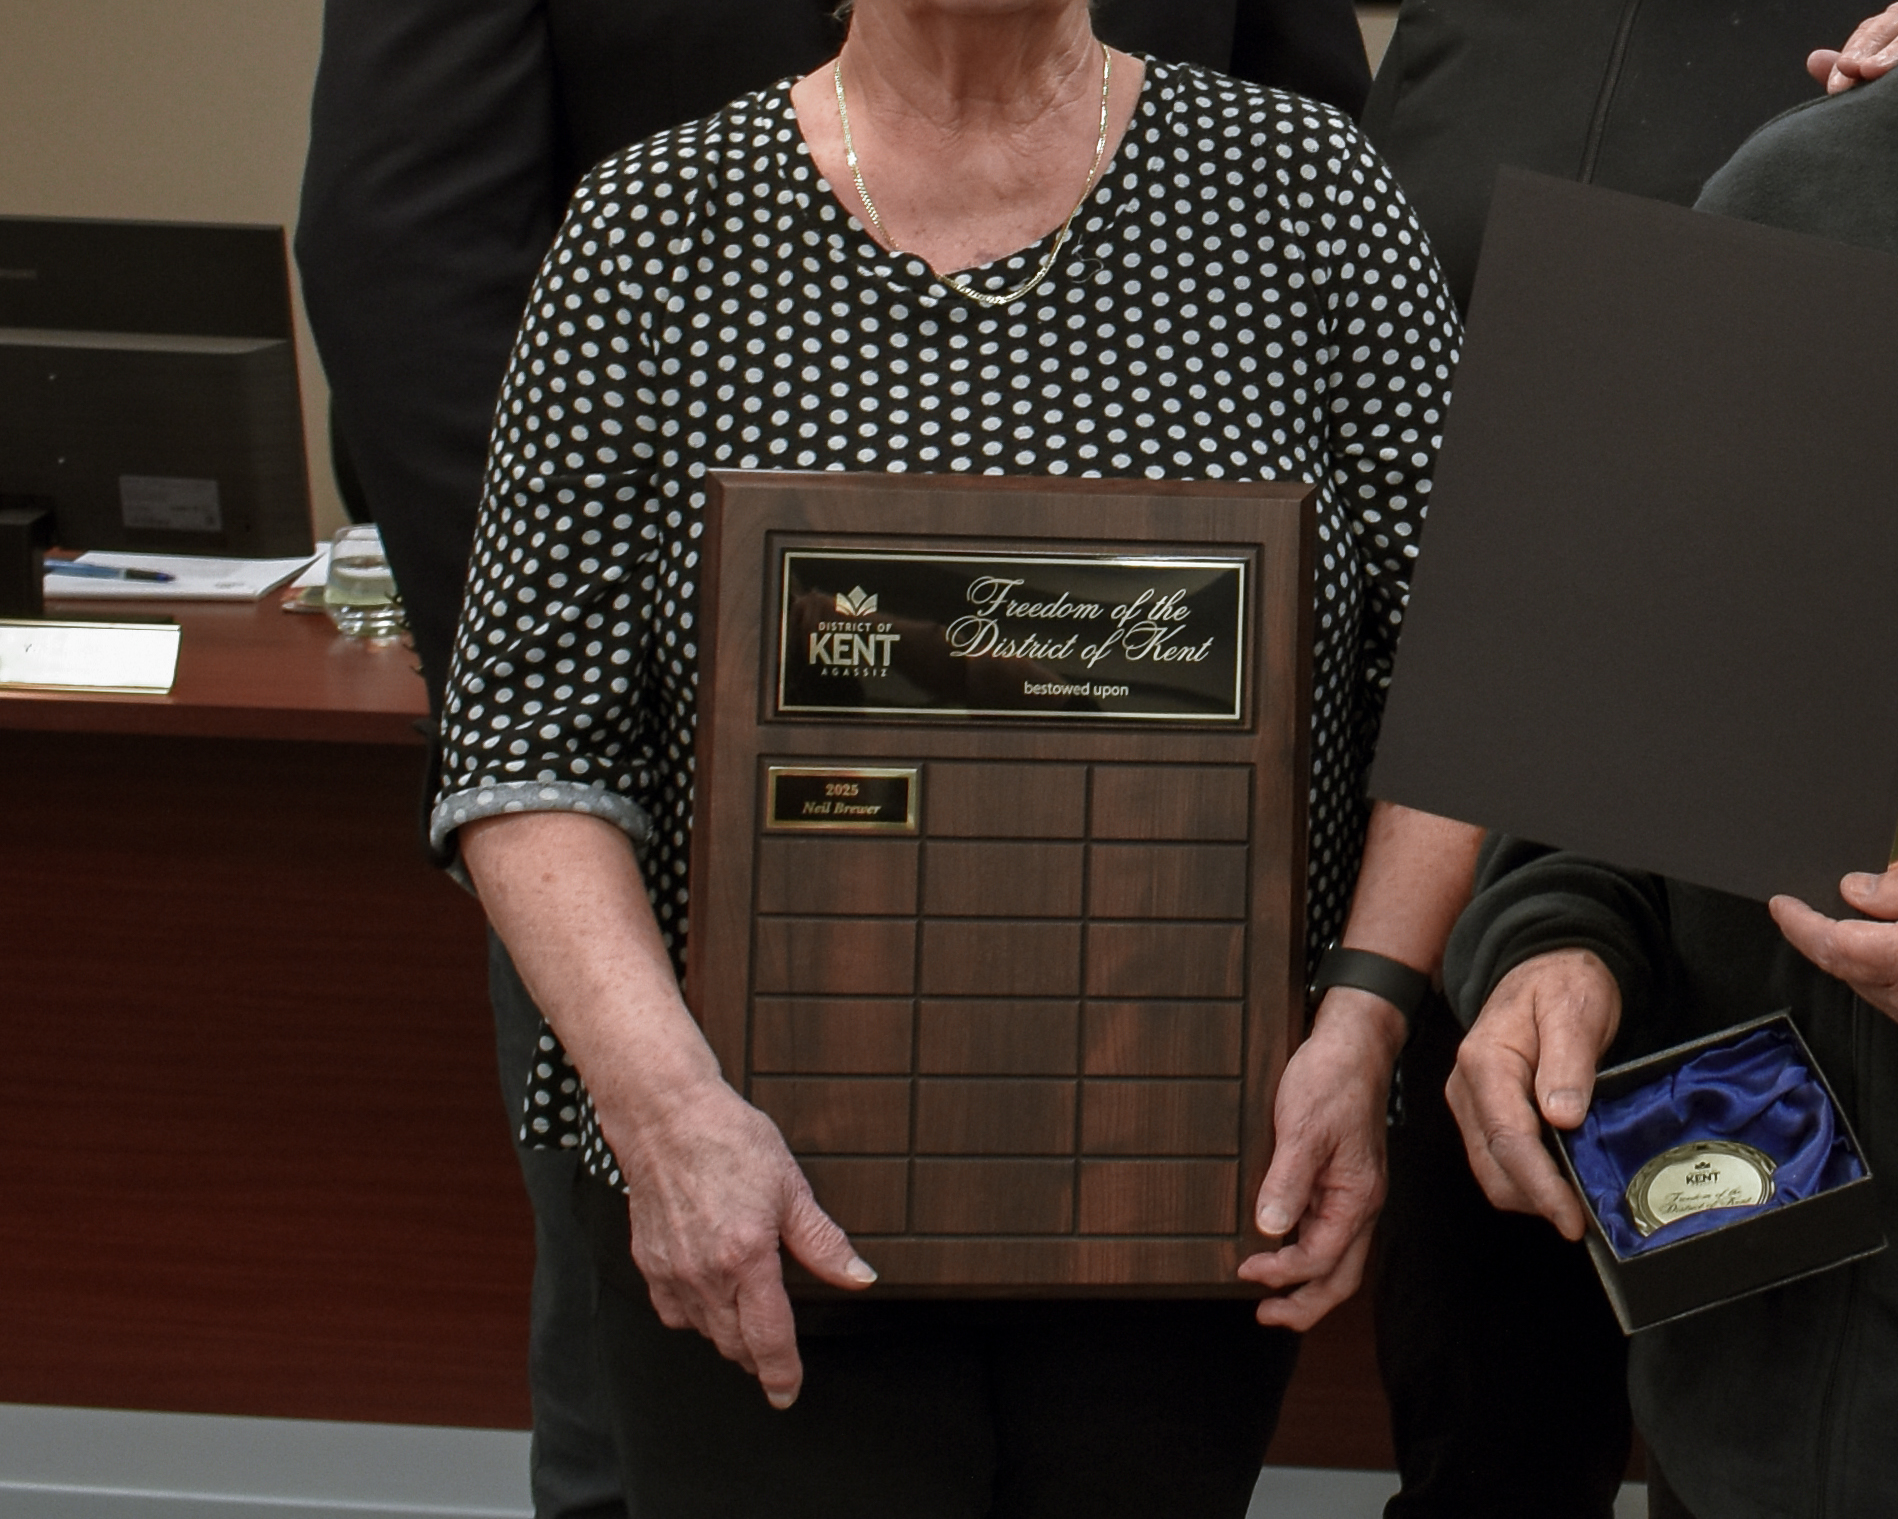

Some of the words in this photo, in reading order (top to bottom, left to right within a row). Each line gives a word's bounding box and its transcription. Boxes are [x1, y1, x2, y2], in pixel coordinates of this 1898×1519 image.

[966, 575, 1104, 620] Freedom
[1110, 588, 1155, 628] of
[1147, 588, 1191, 621] the
[818, 621, 872, 632] DISTRICT
[877, 623, 893, 632] OF
[945, 615, 1074, 659] District
[1080, 628, 1124, 669] of
[1121, 620, 1214, 662] Kent
[809, 632, 900, 667] KENT
[821, 667, 888, 677] AGASSIZ
[1024, 681, 1090, 696] bestowed
[1093, 684, 1129, 699] upon
[825, 783, 859, 796] 2025
[802, 801, 831, 814] Neil
[833, 802, 882, 815] Brewer
[1685, 1171, 1720, 1185] KENT
